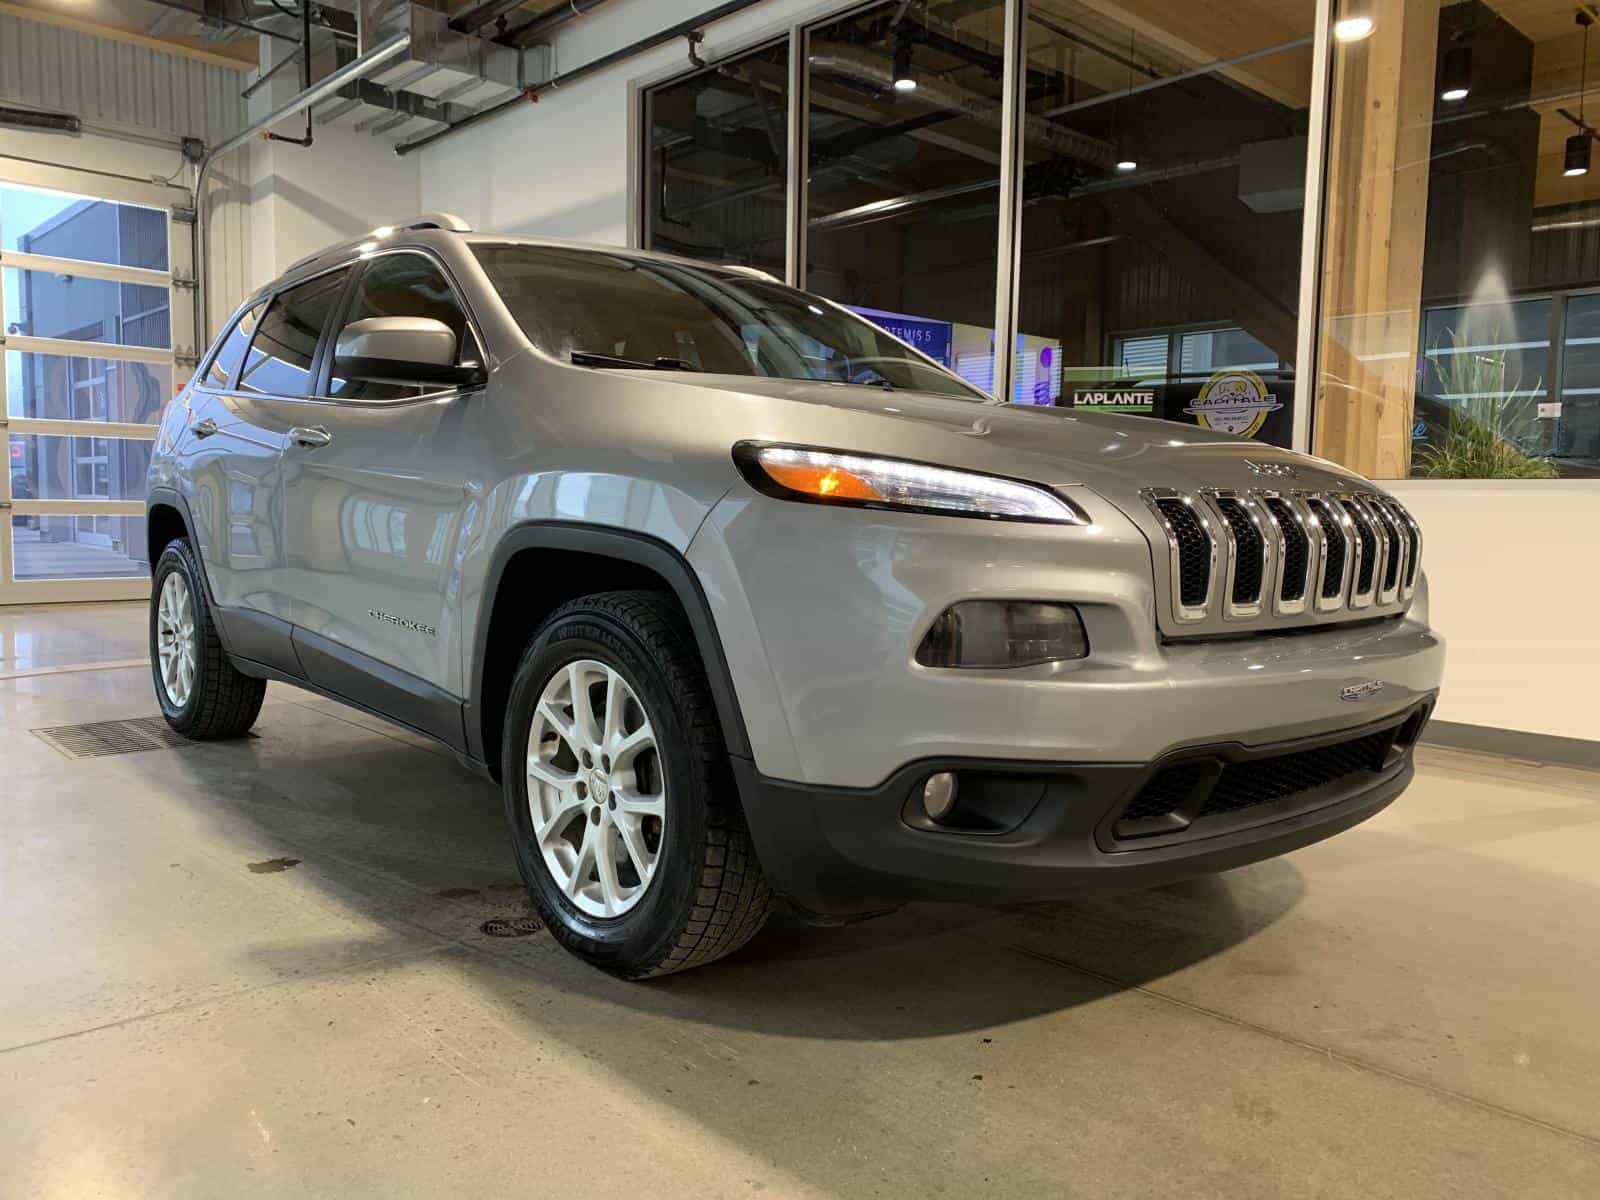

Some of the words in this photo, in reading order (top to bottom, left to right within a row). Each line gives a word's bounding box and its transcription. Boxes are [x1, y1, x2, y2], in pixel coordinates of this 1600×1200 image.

[884, 326, 922, 341] RTEMIS
[925, 330, 932, 342] 5
[1073, 392, 1154, 405] LAPLANTE
[1191, 395, 1275, 407] CAPITALE
